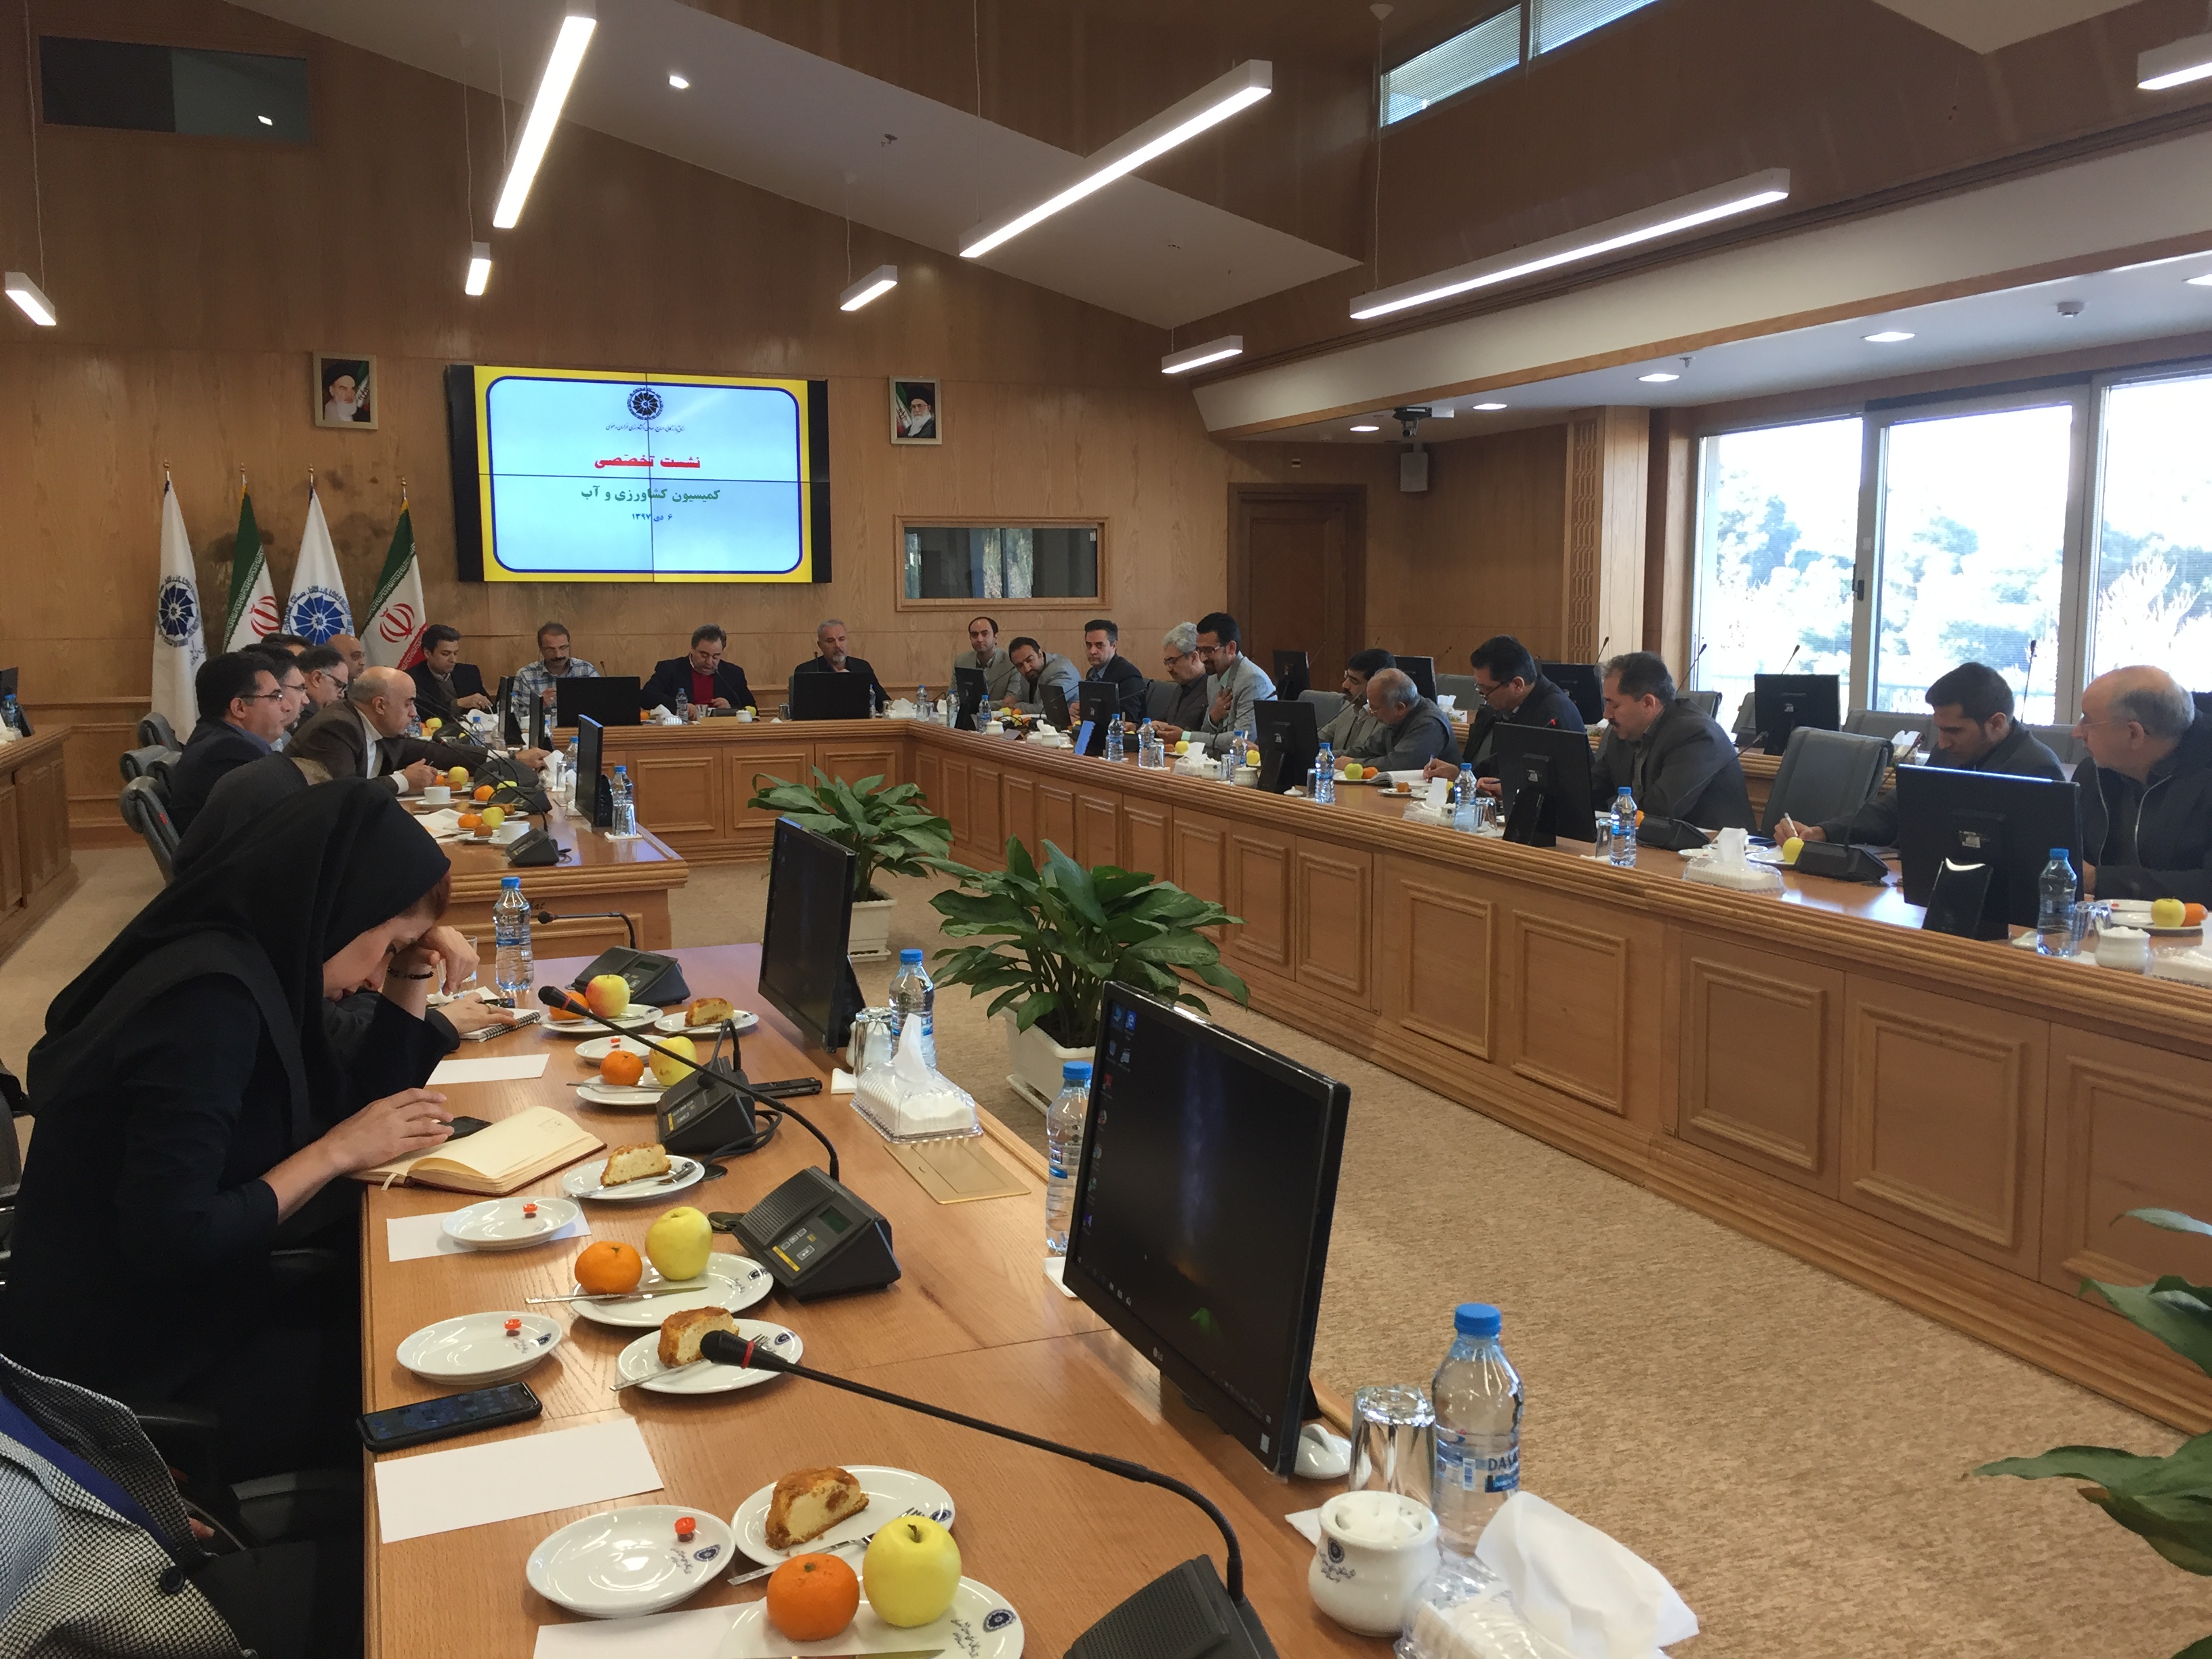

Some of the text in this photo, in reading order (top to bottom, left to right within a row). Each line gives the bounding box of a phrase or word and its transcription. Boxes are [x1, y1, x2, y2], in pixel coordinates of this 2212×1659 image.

[594, 454, 700, 468] نشست تخصصی
[581, 485, 720, 502] کمیسیون کشاورزی و آب
